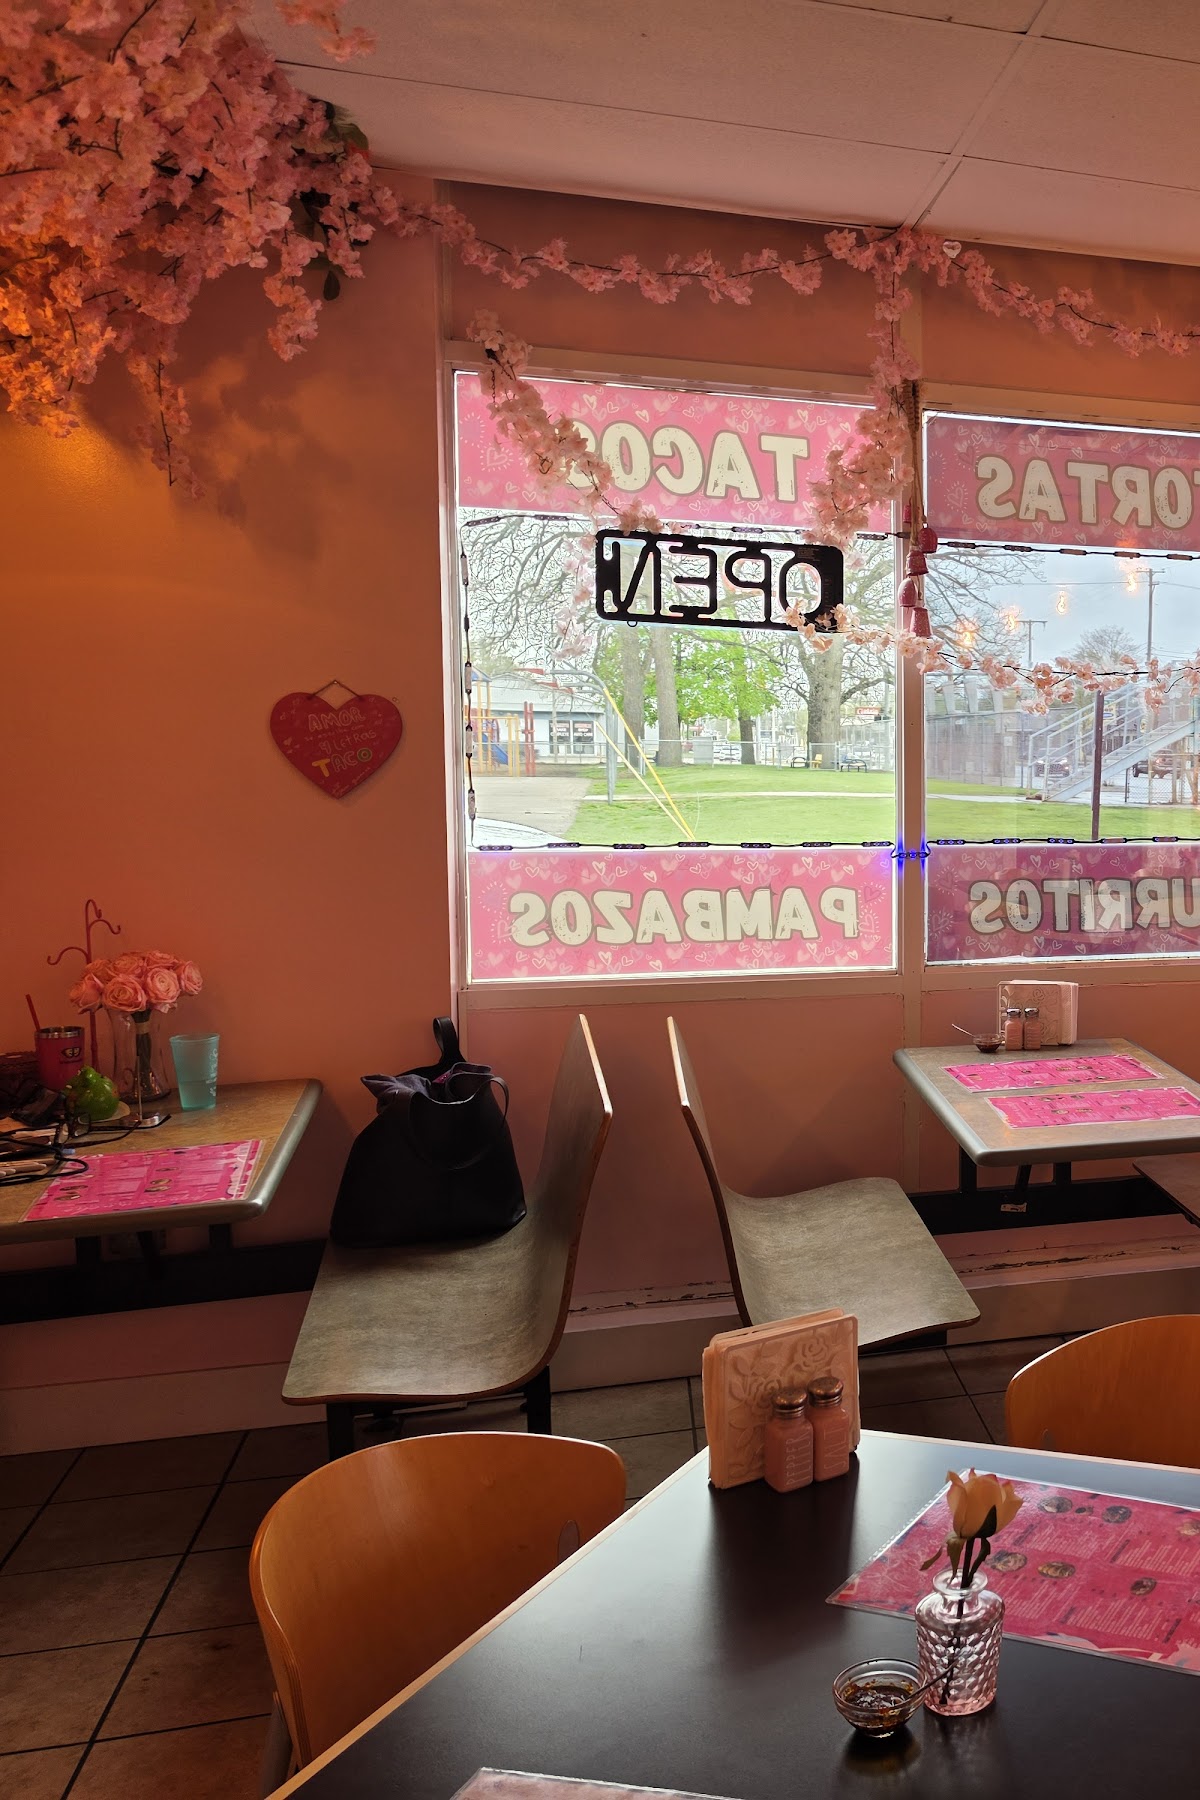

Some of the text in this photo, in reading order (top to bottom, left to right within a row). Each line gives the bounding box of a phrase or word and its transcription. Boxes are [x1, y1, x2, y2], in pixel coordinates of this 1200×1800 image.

[308, 707, 367, 732] AMOR
[312, 747, 373, 778] TACO
[785, 1429, 812, 1486] PEPPER
[823, 1426, 848, 1473] SALT
